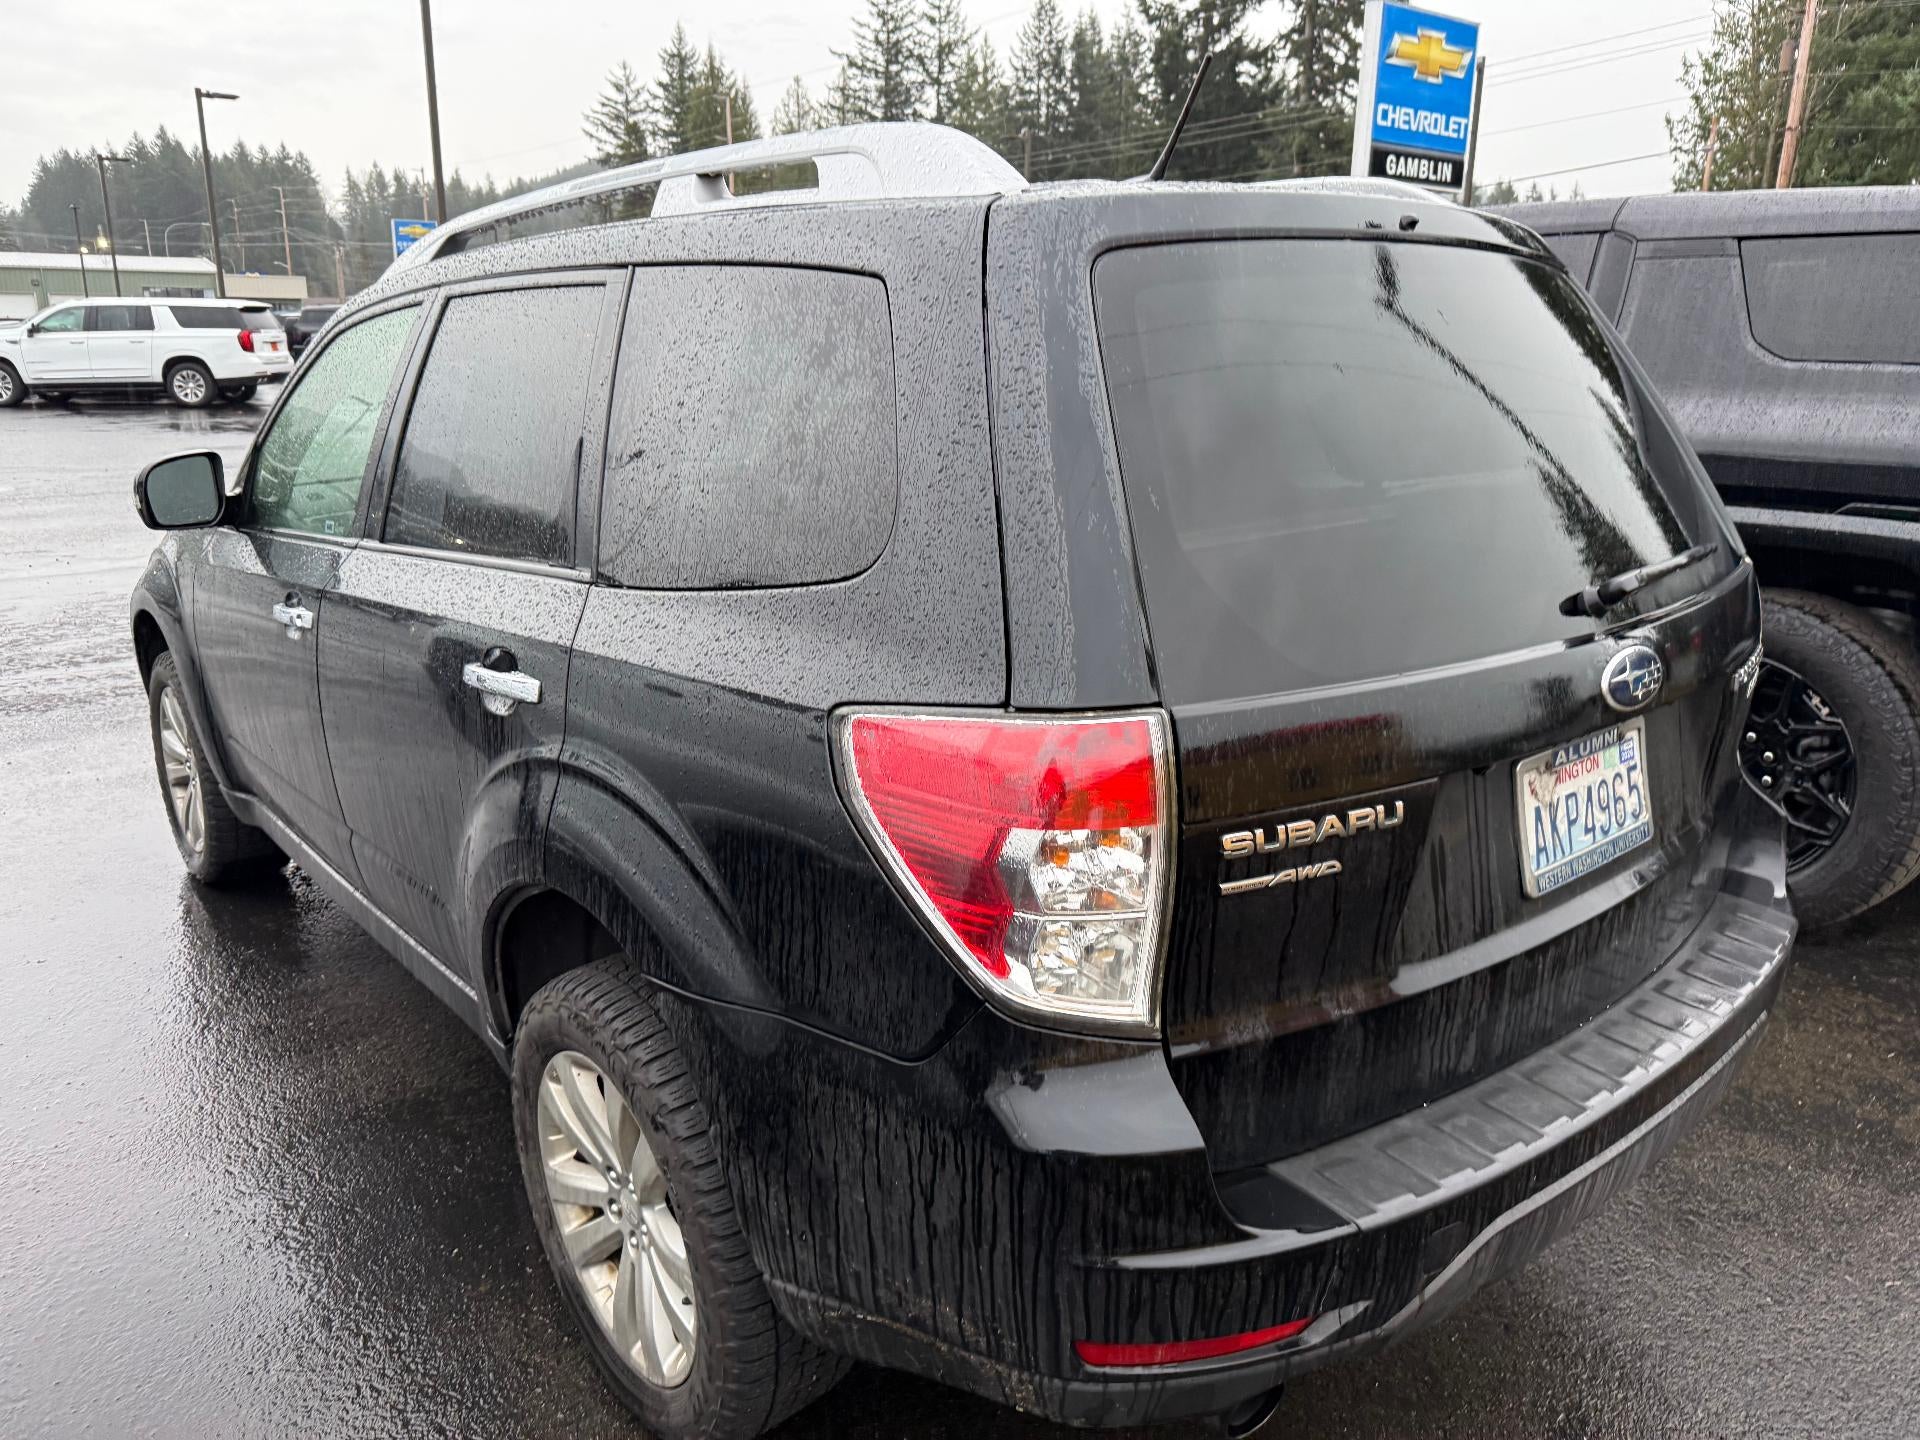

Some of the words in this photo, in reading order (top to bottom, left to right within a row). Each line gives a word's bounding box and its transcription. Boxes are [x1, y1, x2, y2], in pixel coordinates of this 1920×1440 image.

[1377, 102, 1468, 139] CHEVROLET
[1386, 153, 1452, 183] GAMBLIN
[1555, 727, 1618, 767] ALUMNI
[1222, 800, 1404, 860] SUBARU
[1534, 764, 1643, 869] AKP4965
[1269, 860, 1342, 888] AWD
[1537, 863, 1572, 894] WESTERN
[1573, 842, 1614, 875] WASHINGTON
[1614, 822, 1650, 852] UNIVERSITY
